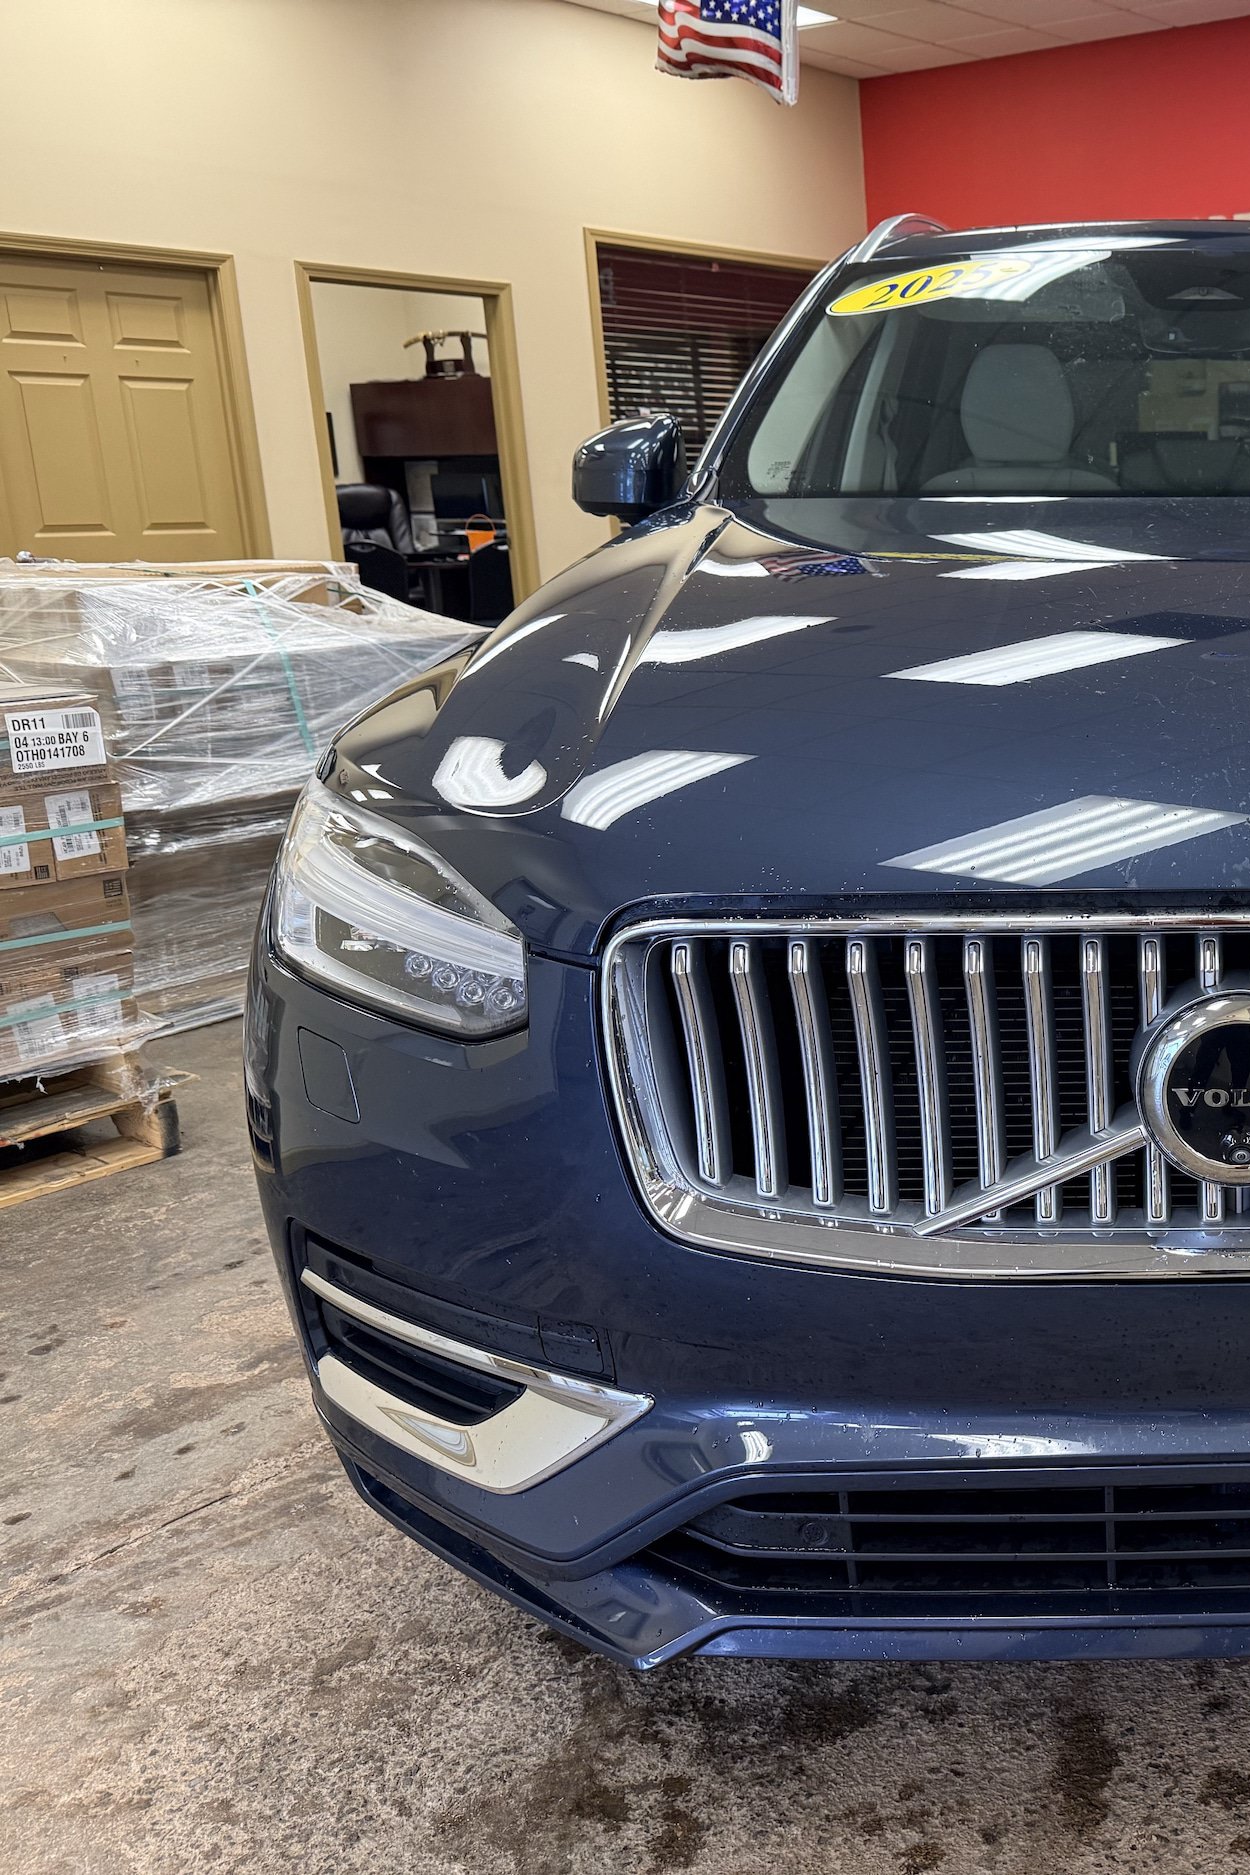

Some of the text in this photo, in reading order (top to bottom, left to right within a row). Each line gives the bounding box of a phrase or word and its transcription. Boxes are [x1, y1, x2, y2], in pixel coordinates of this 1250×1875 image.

[863, 262, 996, 309] 2025
[11, 717, 46, 731] DR11
[14, 730, 89, 749] 04 13:00 BAY 6
[17, 761, 46, 771] 2550 LBS
